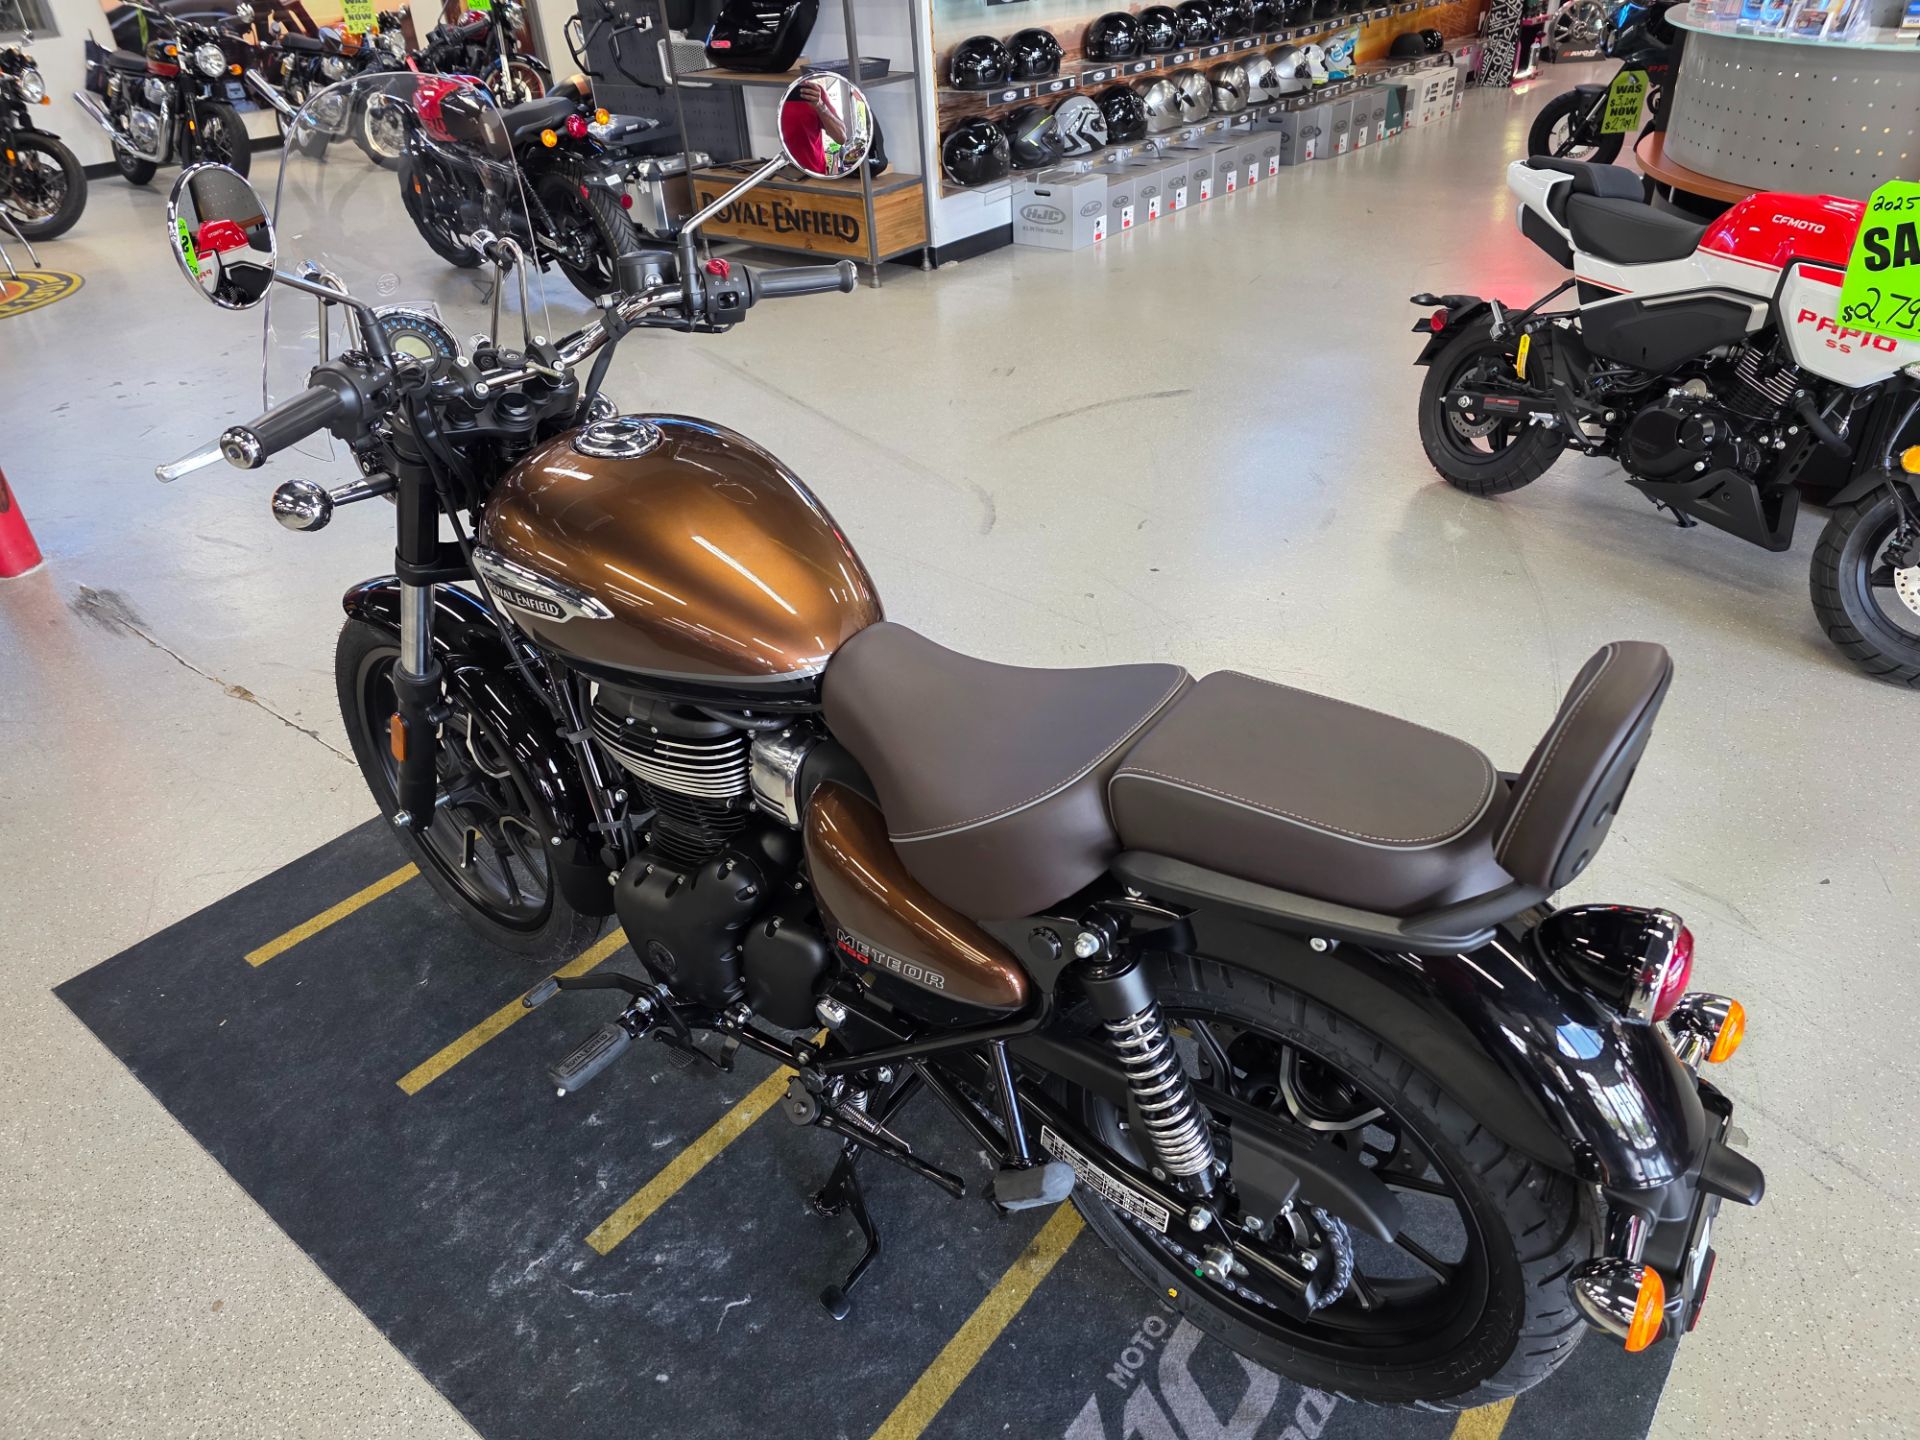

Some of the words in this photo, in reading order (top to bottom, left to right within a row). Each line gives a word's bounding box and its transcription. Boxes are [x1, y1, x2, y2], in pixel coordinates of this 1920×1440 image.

[1616, 84, 1642, 94] WAS
[1610, 106, 1638, 116] NOW
[1026, 208, 1060, 221] HJC
[1874, 196, 1920, 212] 2025
[772, 200, 860, 243] ENFIELD
[1772, 214, 1826, 234] CFMOTO
[1863, 221, 1920, 272] SA
[1842, 287, 1920, 332] $2,79
[1797, 308, 1898, 354] PAPIO
[1825, 338, 1852, 354] SS
[515, 592, 559, 616] ENFIELD
[836, 928, 945, 990] METEOR
[564, 1050, 585, 1068] ROYAL
[584, 1034, 608, 1055] ENFIELD
[1106, 1315, 1168, 1390] MOTO
